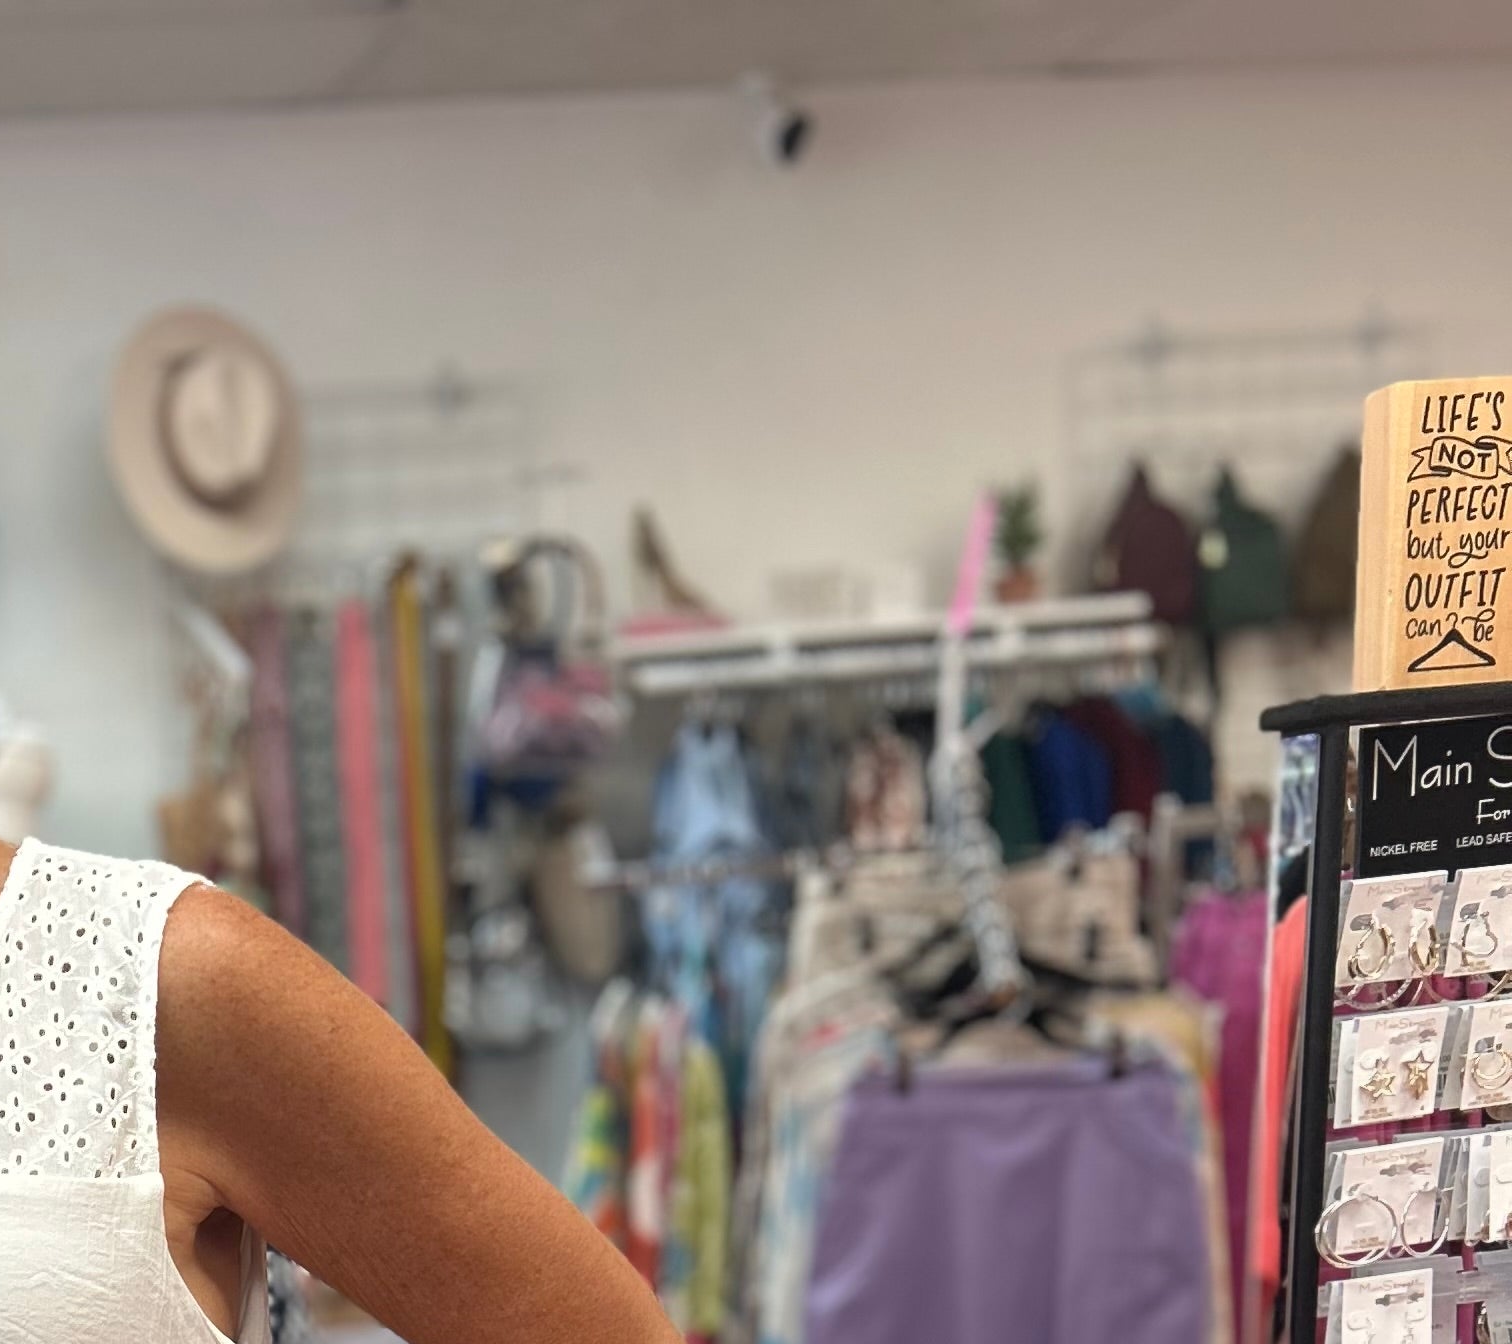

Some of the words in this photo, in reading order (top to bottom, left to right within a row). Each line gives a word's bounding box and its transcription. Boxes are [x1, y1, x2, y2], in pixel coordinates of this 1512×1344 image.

[1422, 391, 1505, 433] LIFE'S
[1438, 442, 1492, 473] NOT
[1406, 482, 1512, 529] PERFECT
[1407, 529, 1450, 560] but
[1448, 527, 1512, 569] your
[1405, 567, 1507, 612] OUTFIT
[1405, 618, 1443, 640] can
[1461, 608, 1496, 642] be
[1372, 734, 1473, 801] Main
[1476, 798, 1511, 825] For
[1369, 843, 1409, 857] NICKEL
[1409, 839, 1439, 854] FREE
[1455, 835, 1485, 849] LEAD
[1485, 831, 1512, 845] SAFE
